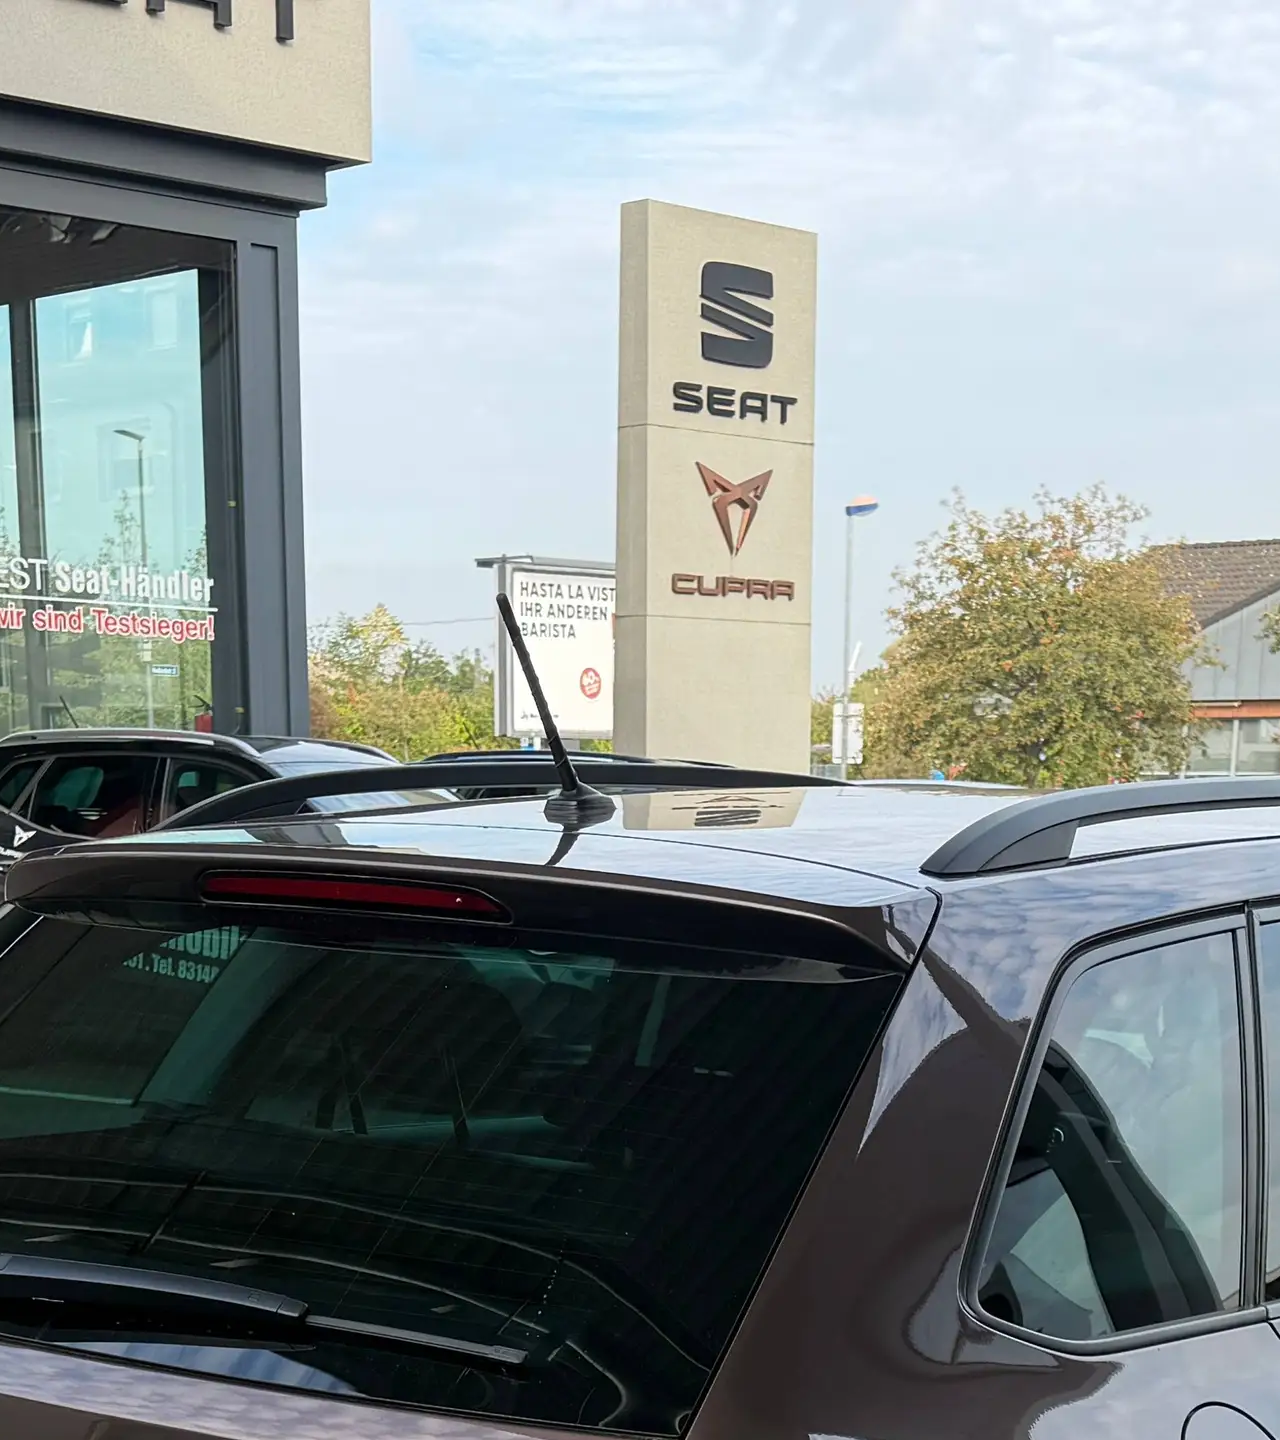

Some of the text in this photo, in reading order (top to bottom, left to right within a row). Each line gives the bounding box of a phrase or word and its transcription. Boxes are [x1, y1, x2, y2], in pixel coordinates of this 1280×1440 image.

[672, 381, 798, 425] SEAT
[55, 559, 215, 602] Seat-Händler
[520, 581, 564, 599] HASTA
[568, 584, 584, 600] LA
[671, 573, 795, 602] CUPRA
[32, 604, 83, 634] sind
[91, 608, 215, 644] Testsieger!
[520, 602, 608, 621] IHR ANDEREN
[521, 622, 576, 639] BARISTA
